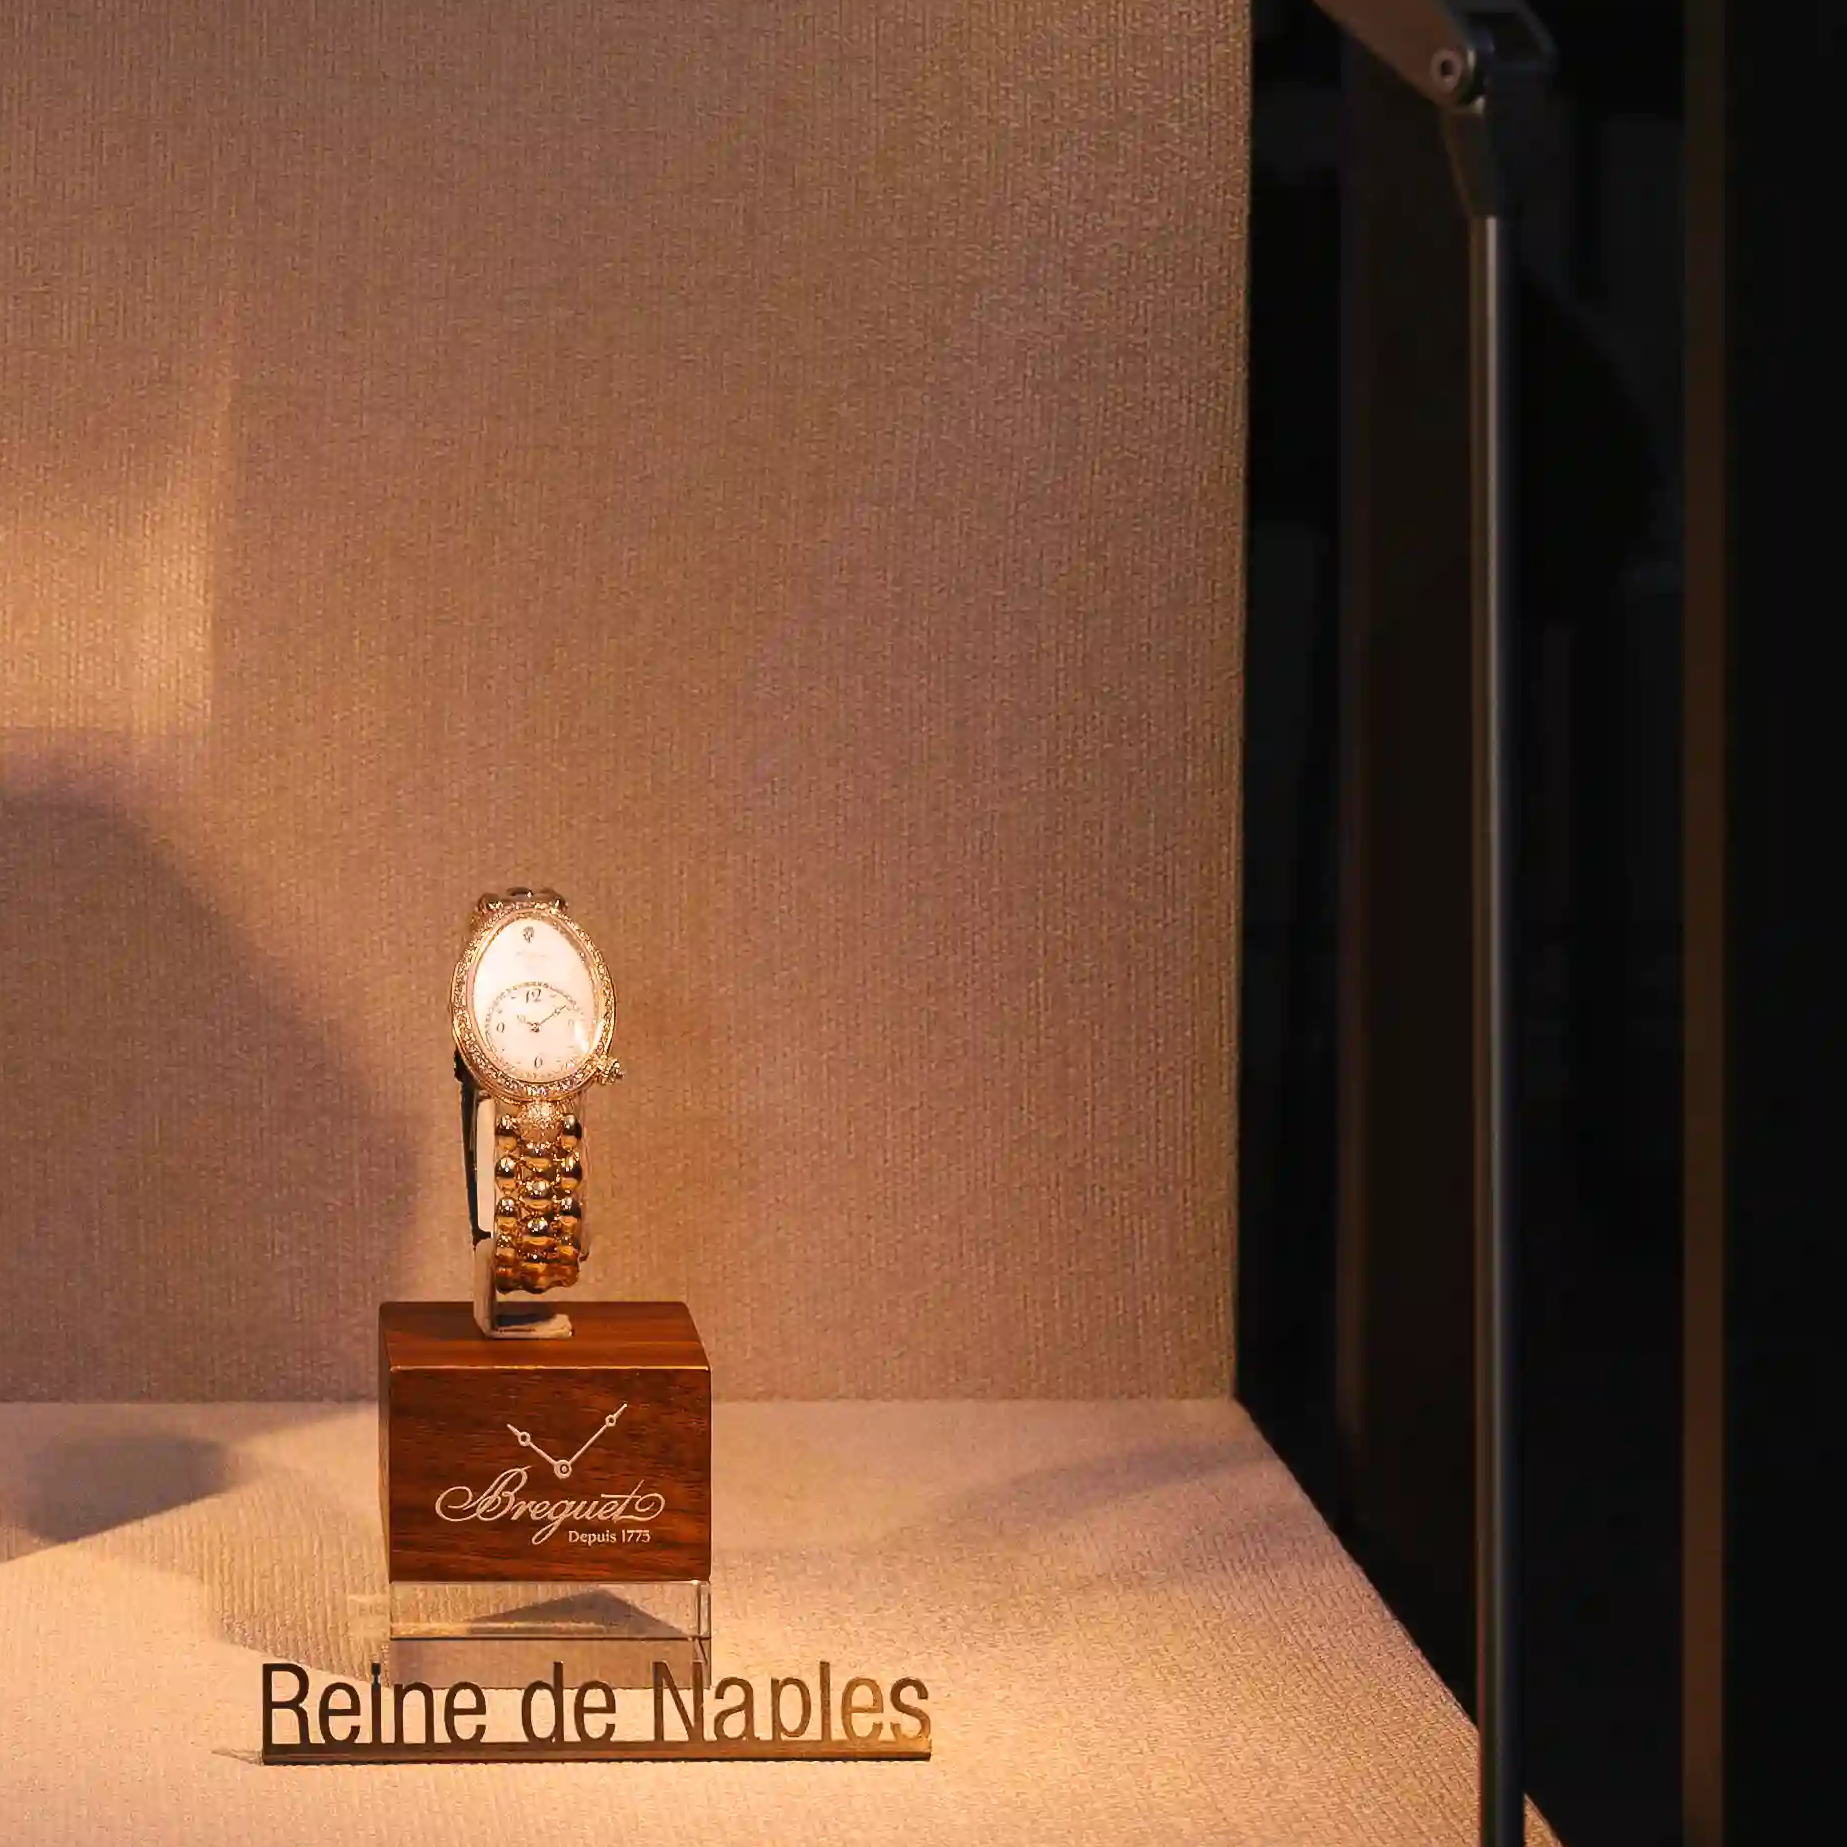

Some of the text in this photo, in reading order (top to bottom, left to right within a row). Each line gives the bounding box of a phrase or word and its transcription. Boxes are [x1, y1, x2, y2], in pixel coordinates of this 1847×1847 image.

[435, 1465, 666, 1545] Breguet
[568, 1529, 651, 1546] Depuis 1775
[262, 1661, 932, 1747] Reine de Naples
